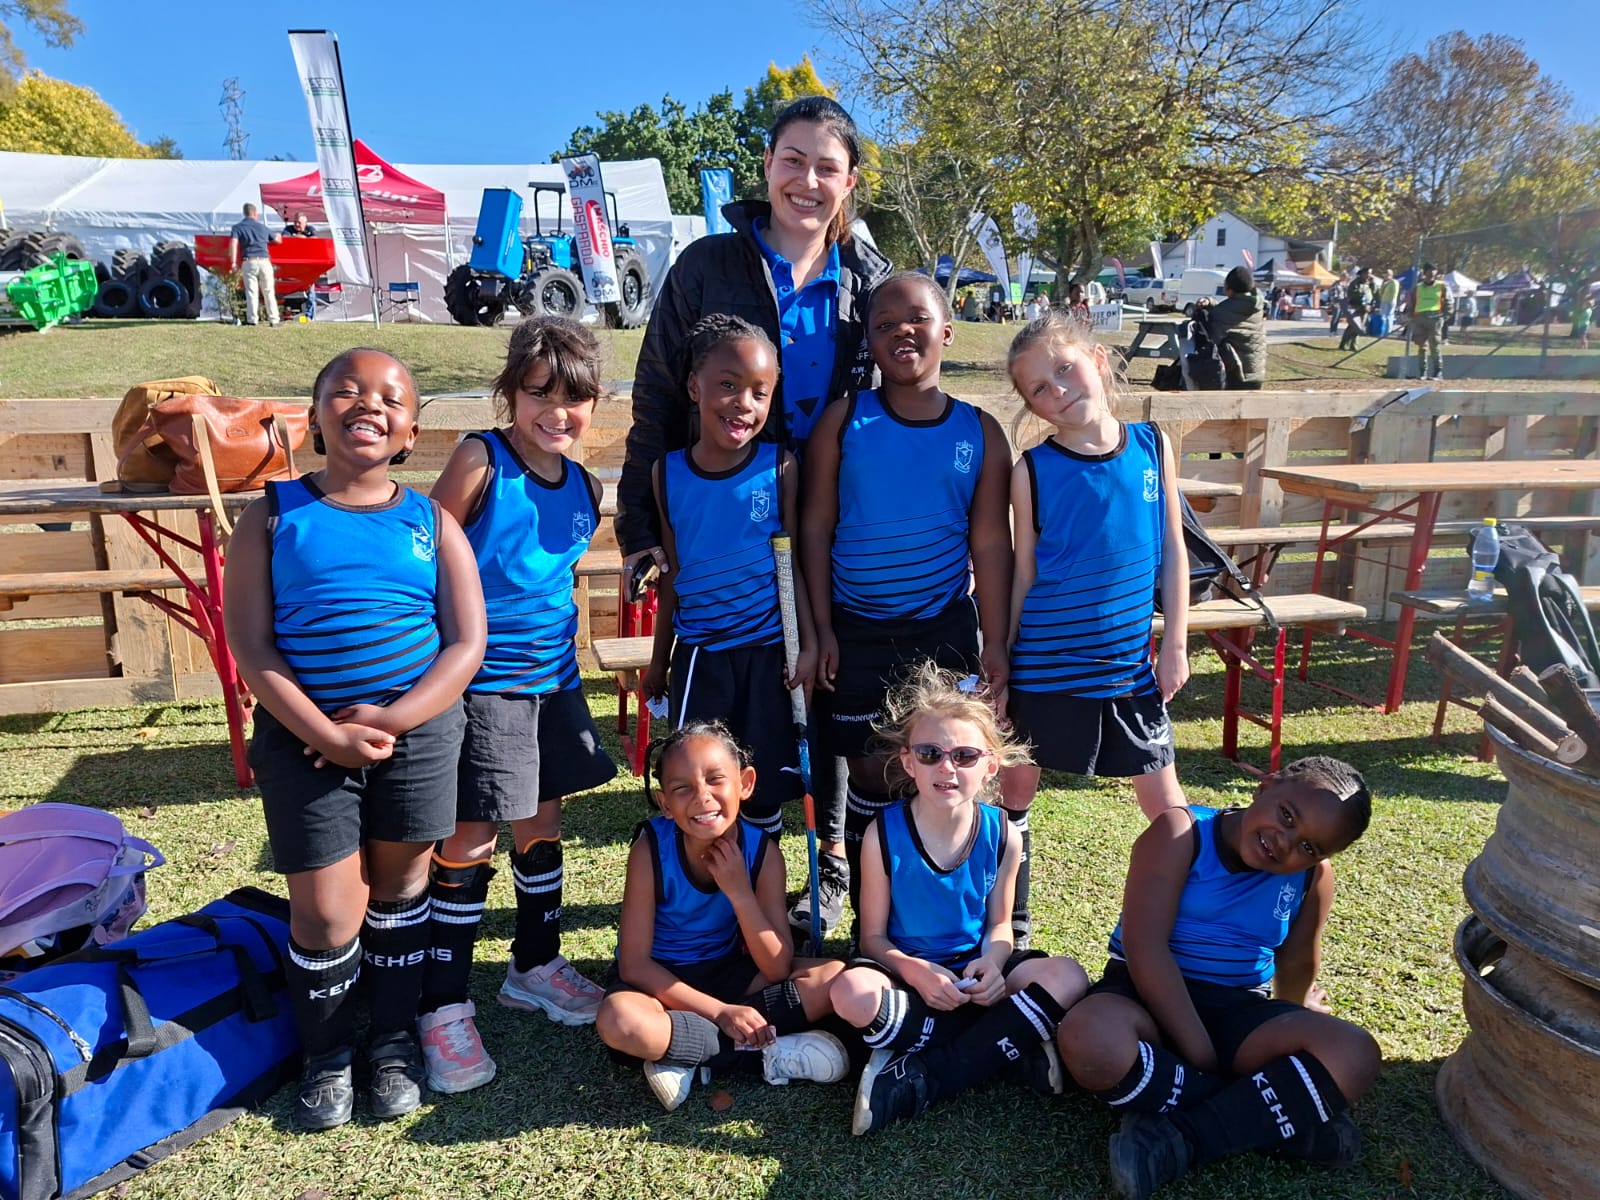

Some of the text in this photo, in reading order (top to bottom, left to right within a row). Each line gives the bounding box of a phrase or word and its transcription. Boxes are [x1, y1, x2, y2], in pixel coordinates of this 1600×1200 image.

[570, 197, 594, 266] GASPARDO
[594, 207, 610, 258] MASCHIO
[543, 906, 562, 922] KE
[364, 949, 425, 968] KEHS
[309, 965, 361, 1000] KEH
[997, 1036, 1020, 1061] KE
[1252, 1072, 1296, 1140] KEHS
